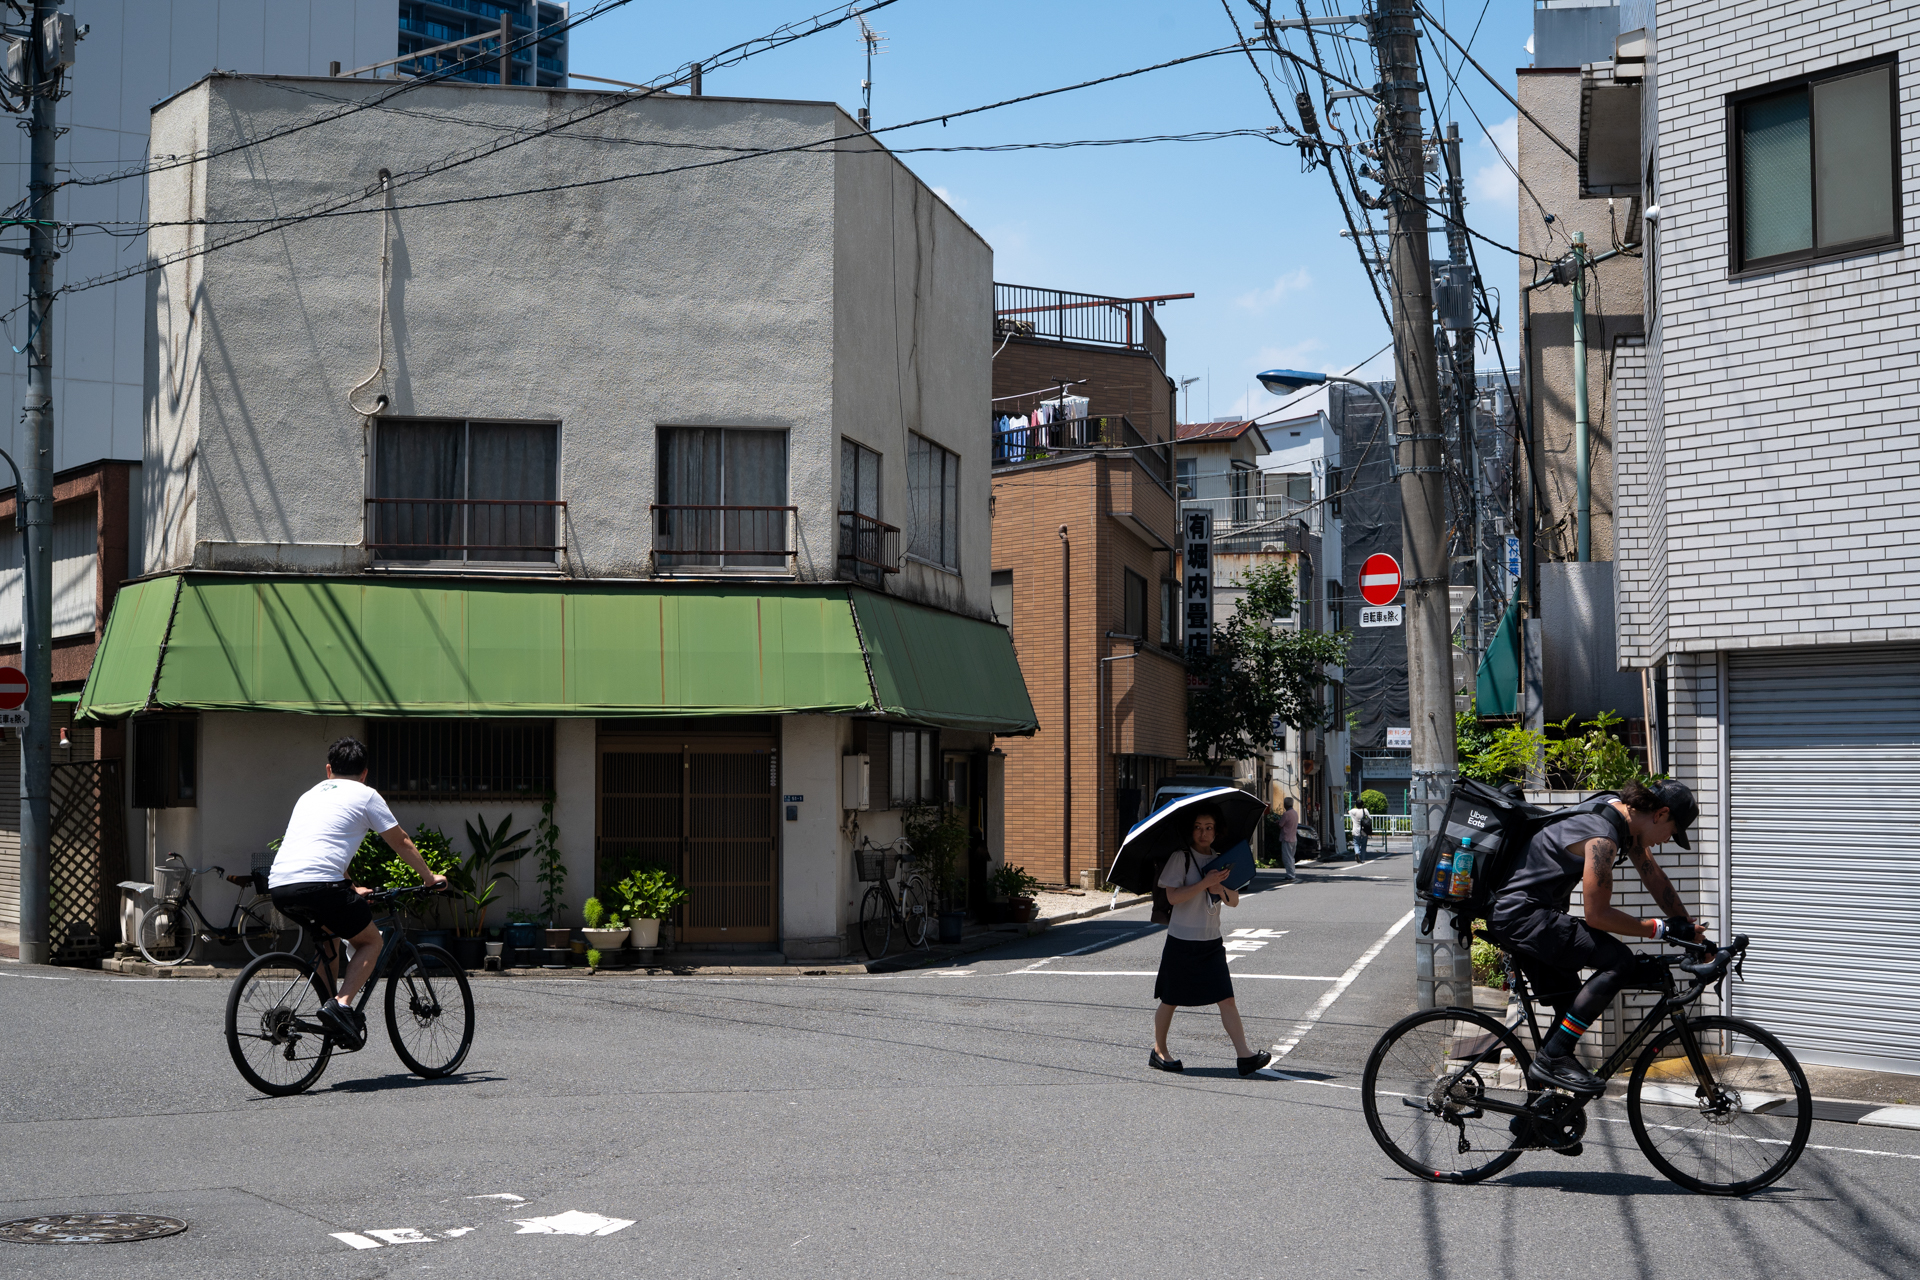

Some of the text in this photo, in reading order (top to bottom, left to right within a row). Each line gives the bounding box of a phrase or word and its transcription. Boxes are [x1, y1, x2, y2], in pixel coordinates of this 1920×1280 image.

[1185, 513, 1209, 656] (有)堀内畳店
[1363, 610, 1399, 623] 自転車を除く
[1470, 810, 1488, 821] Uber
[1468, 817, 1485, 828] Eats
